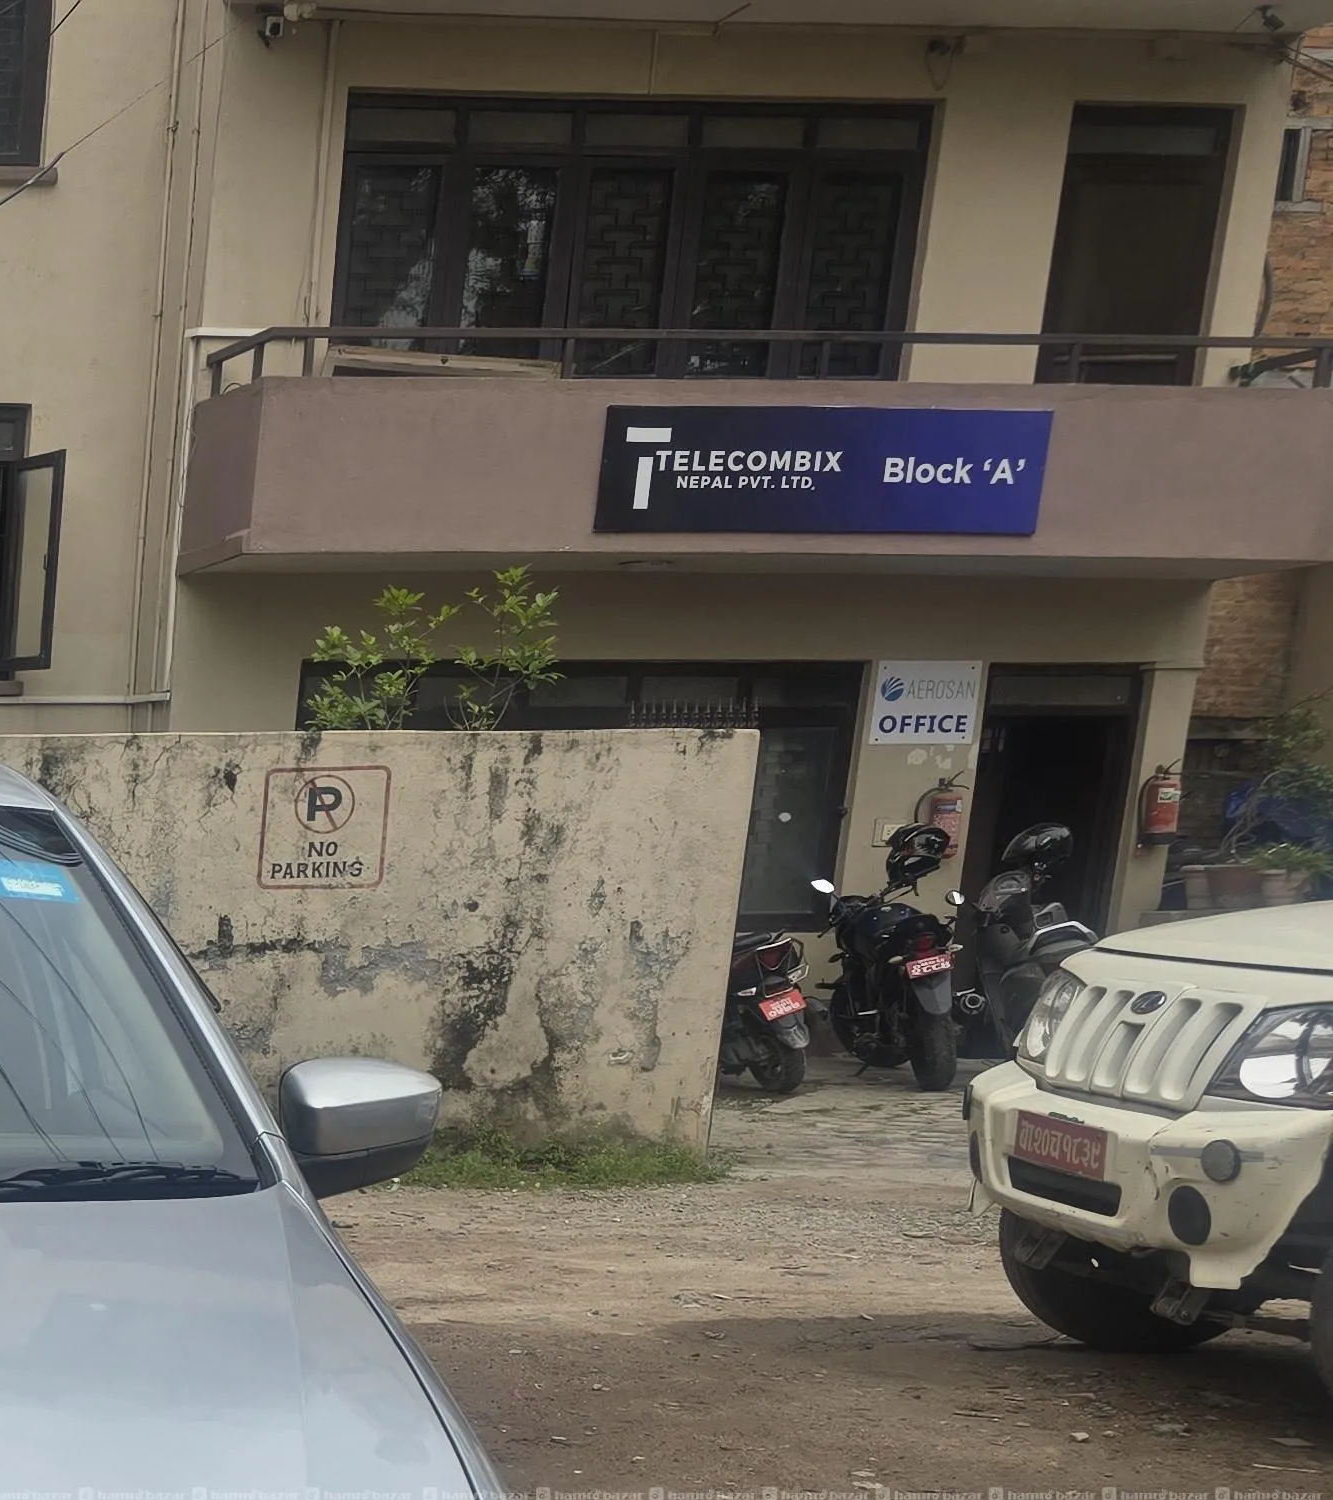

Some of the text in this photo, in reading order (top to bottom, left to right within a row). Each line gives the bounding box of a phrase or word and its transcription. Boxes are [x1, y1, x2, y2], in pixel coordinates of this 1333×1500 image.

[656, 450, 843, 472] TELECOMBIX
[883, 457, 973, 484] Block
[676, 475, 733, 489] NEPAL
[738, 476, 775, 489] PVT.
[906, 680, 976, 700] AEROSAN
[879, 714, 968, 734] OFFICE
[307, 841, 338, 858] NO
[270, 861, 364, 879] PARKING
